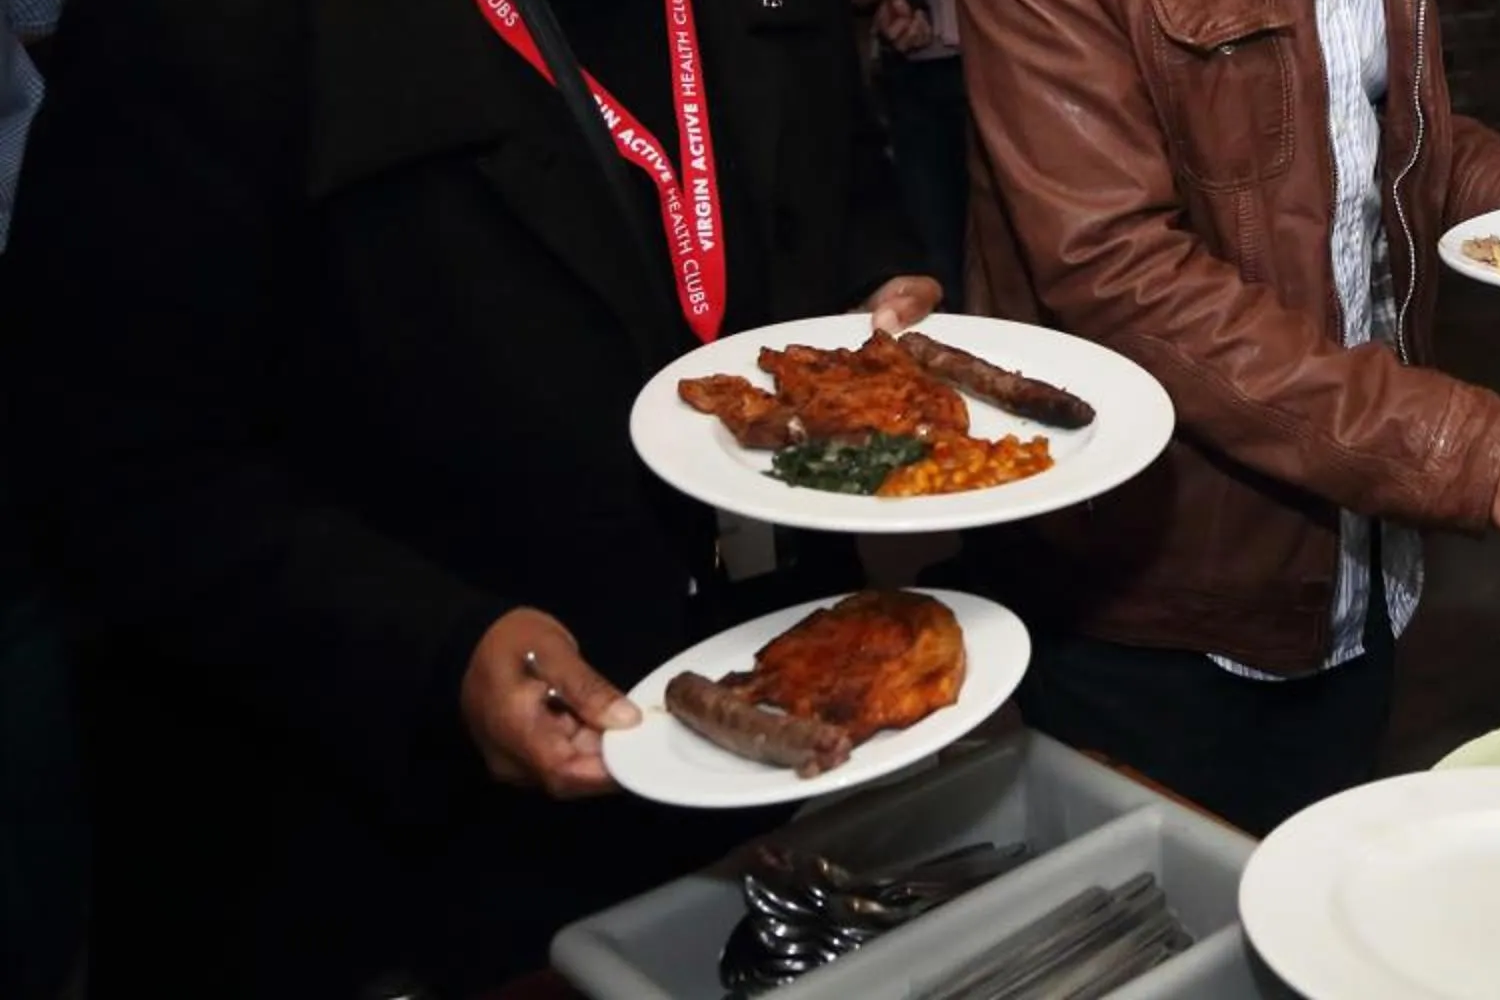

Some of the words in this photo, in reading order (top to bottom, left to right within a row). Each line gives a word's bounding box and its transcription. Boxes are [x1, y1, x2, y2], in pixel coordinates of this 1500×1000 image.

[676, 31, 697, 97] HEALTH
[684, 103, 708, 171] ACTIVE
[618, 128, 673, 182] ACTIVE
[666, 187, 694, 255] HEALTH
[683, 259, 710, 315] CLUBS
[694, 178, 715, 251] VIRGIN
